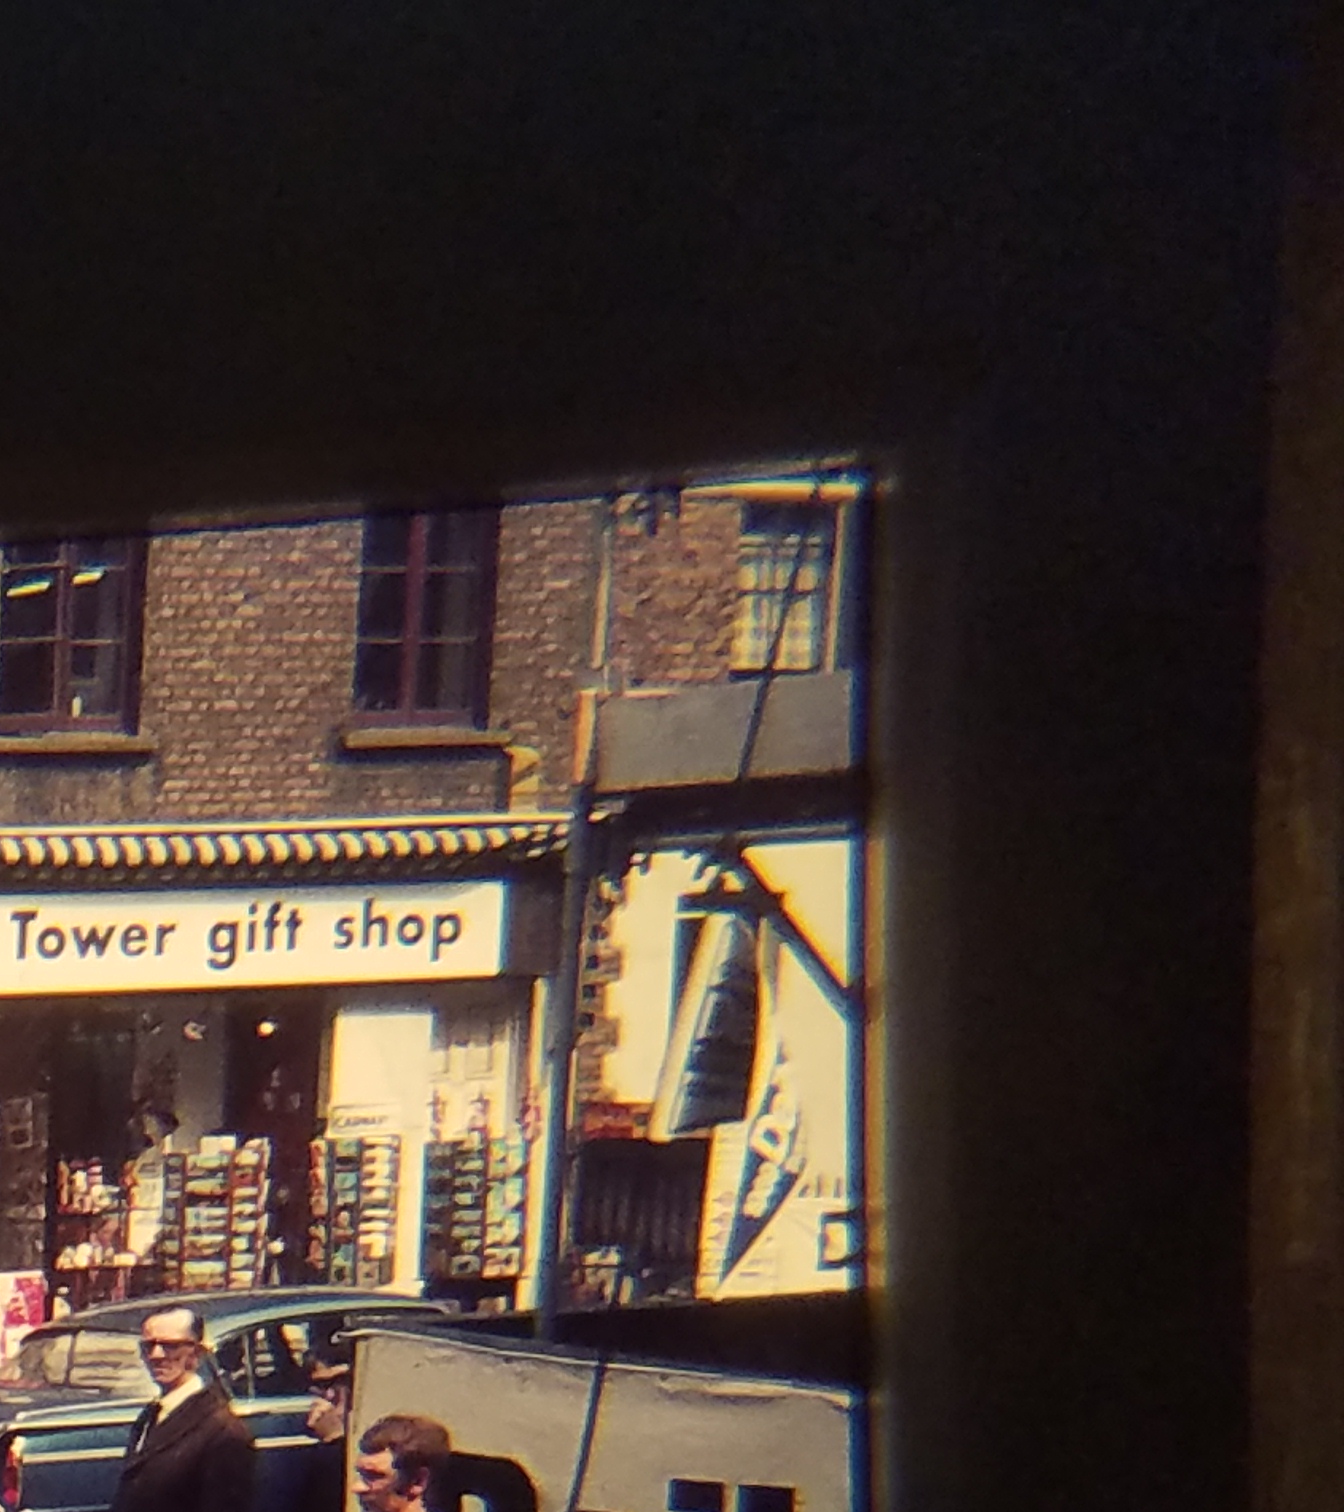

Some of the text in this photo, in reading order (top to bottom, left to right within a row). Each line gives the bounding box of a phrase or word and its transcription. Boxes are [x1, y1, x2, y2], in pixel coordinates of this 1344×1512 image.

[10, 897, 462, 970] Tower gift shop
